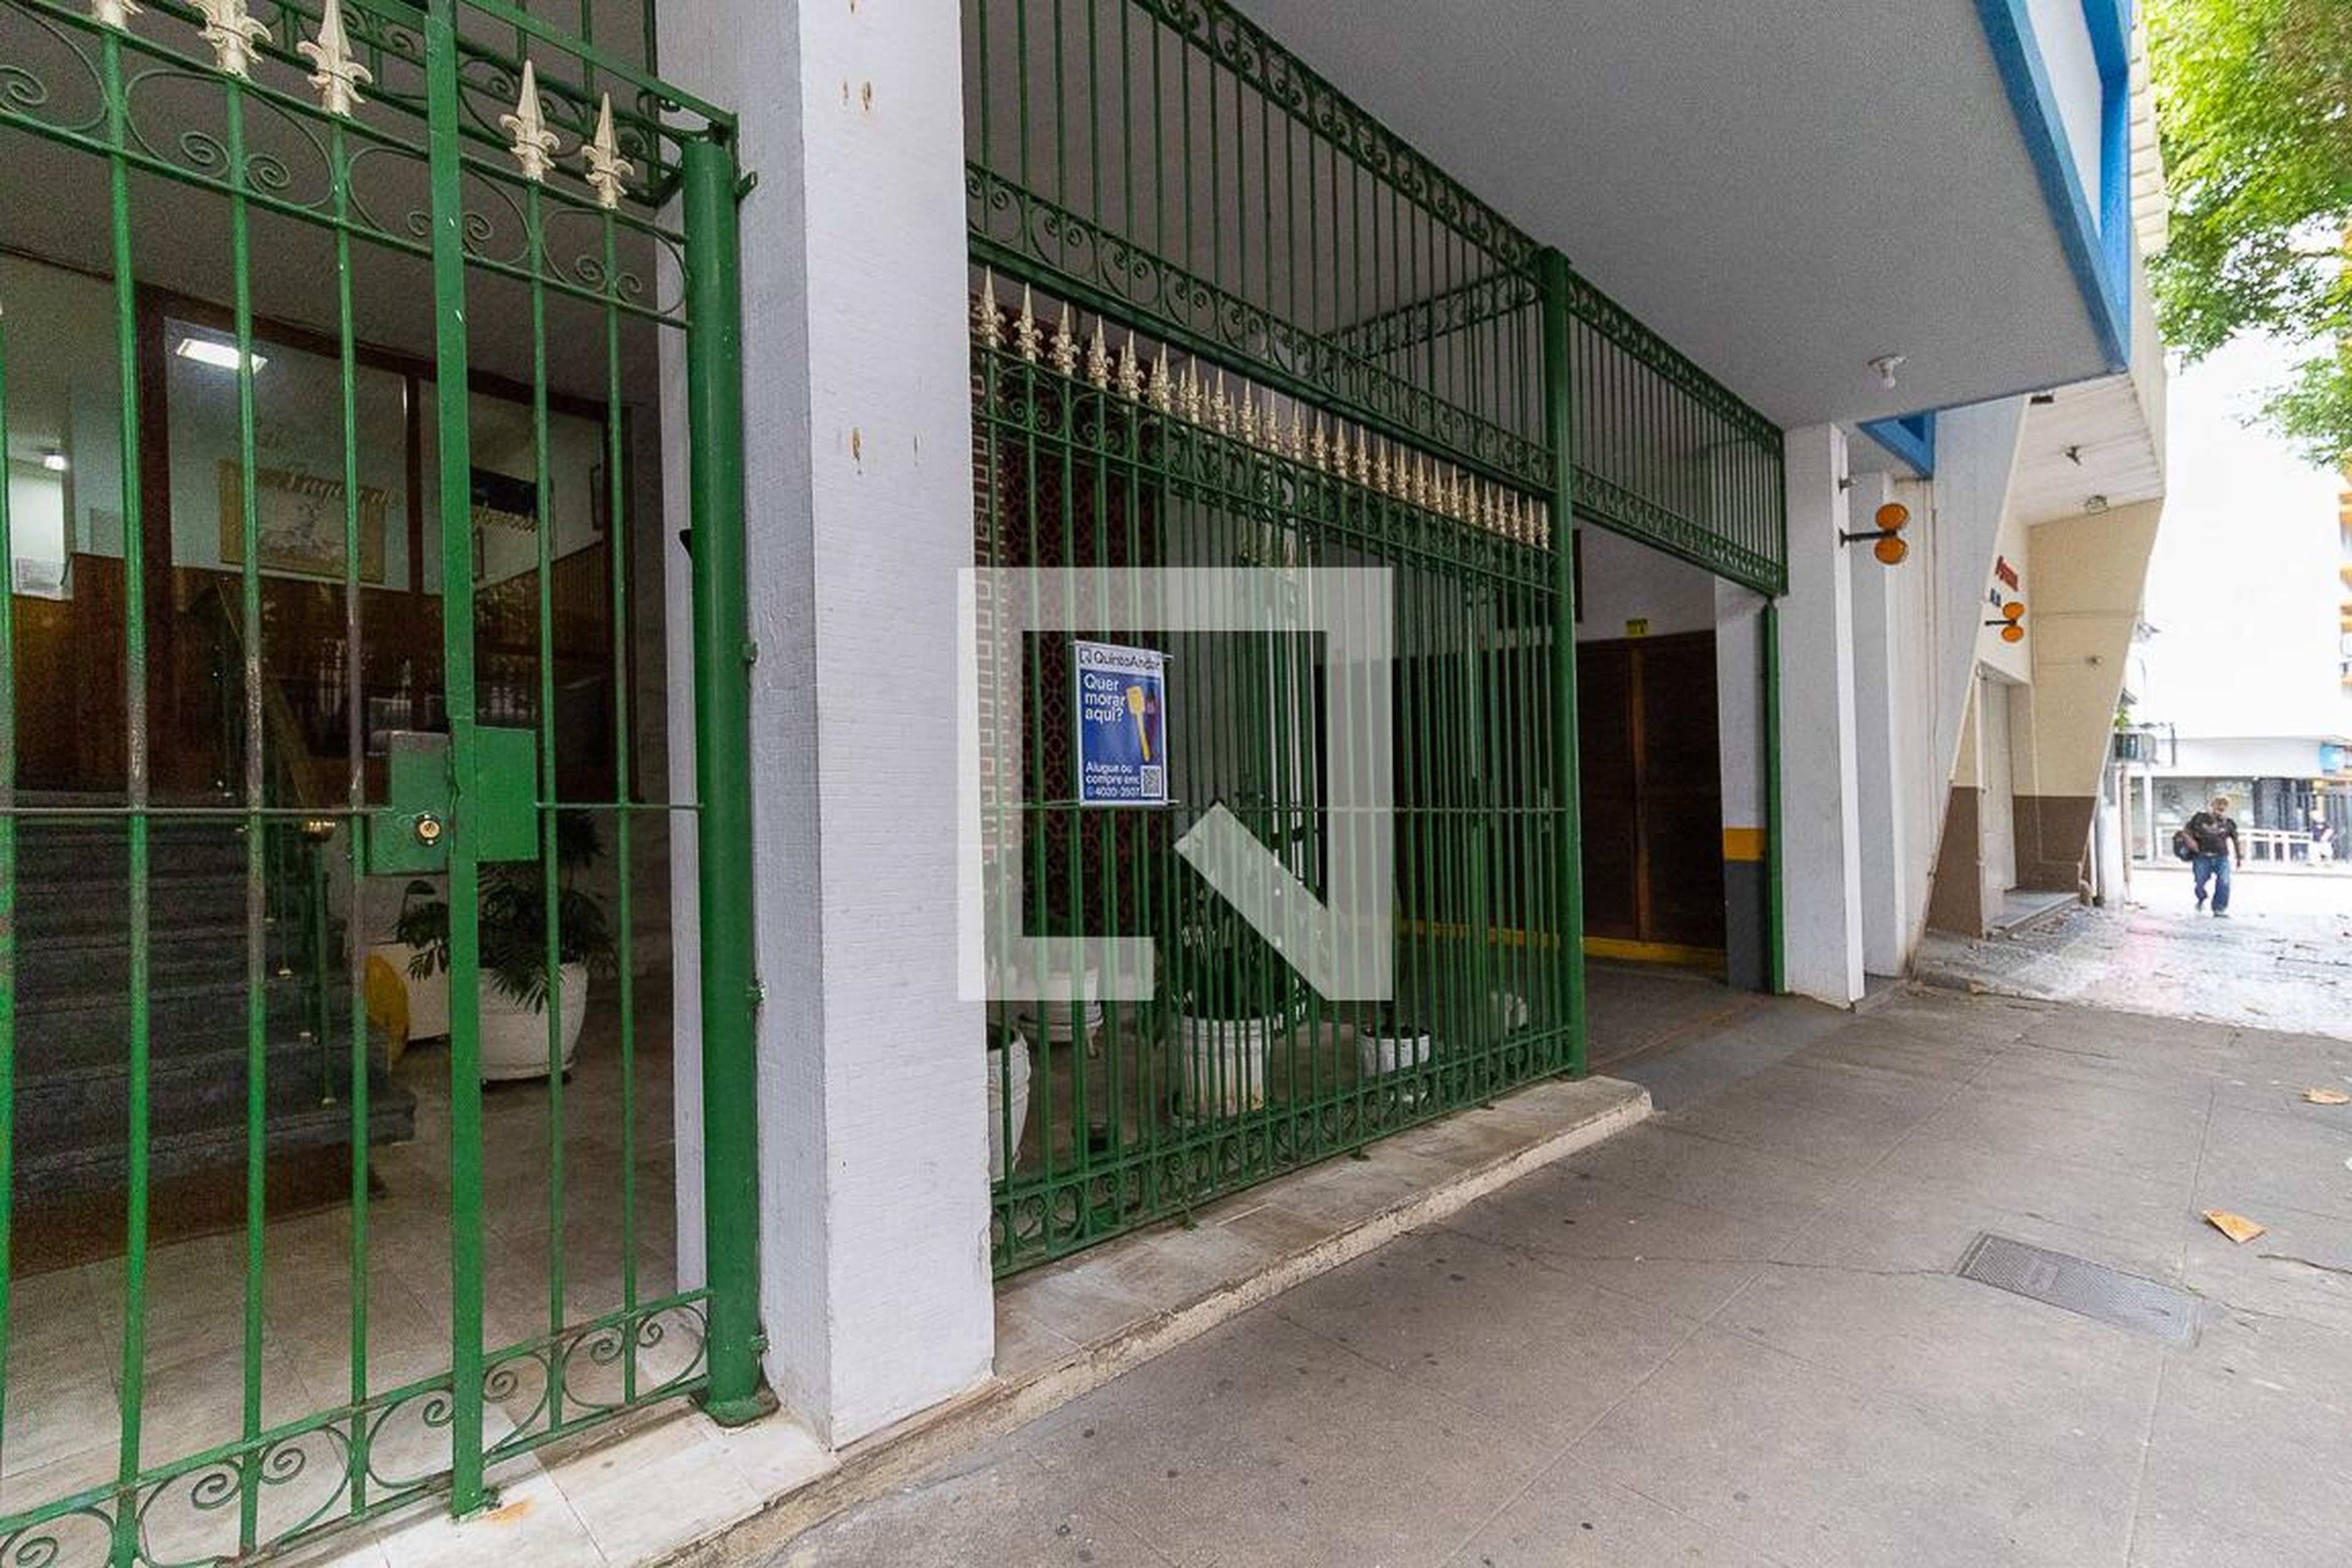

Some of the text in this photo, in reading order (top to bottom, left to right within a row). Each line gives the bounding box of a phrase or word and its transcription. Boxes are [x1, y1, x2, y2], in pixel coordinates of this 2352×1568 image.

[1093, 650, 1160, 671] QuintoAndar
[1084, 673, 1119, 691] Quer
[1085, 693, 1125, 706] morar
[1085, 706, 1123, 725] aqui?
[1121, 764, 1133, 774] ou
[1086, 775, 1122, 786] compre
